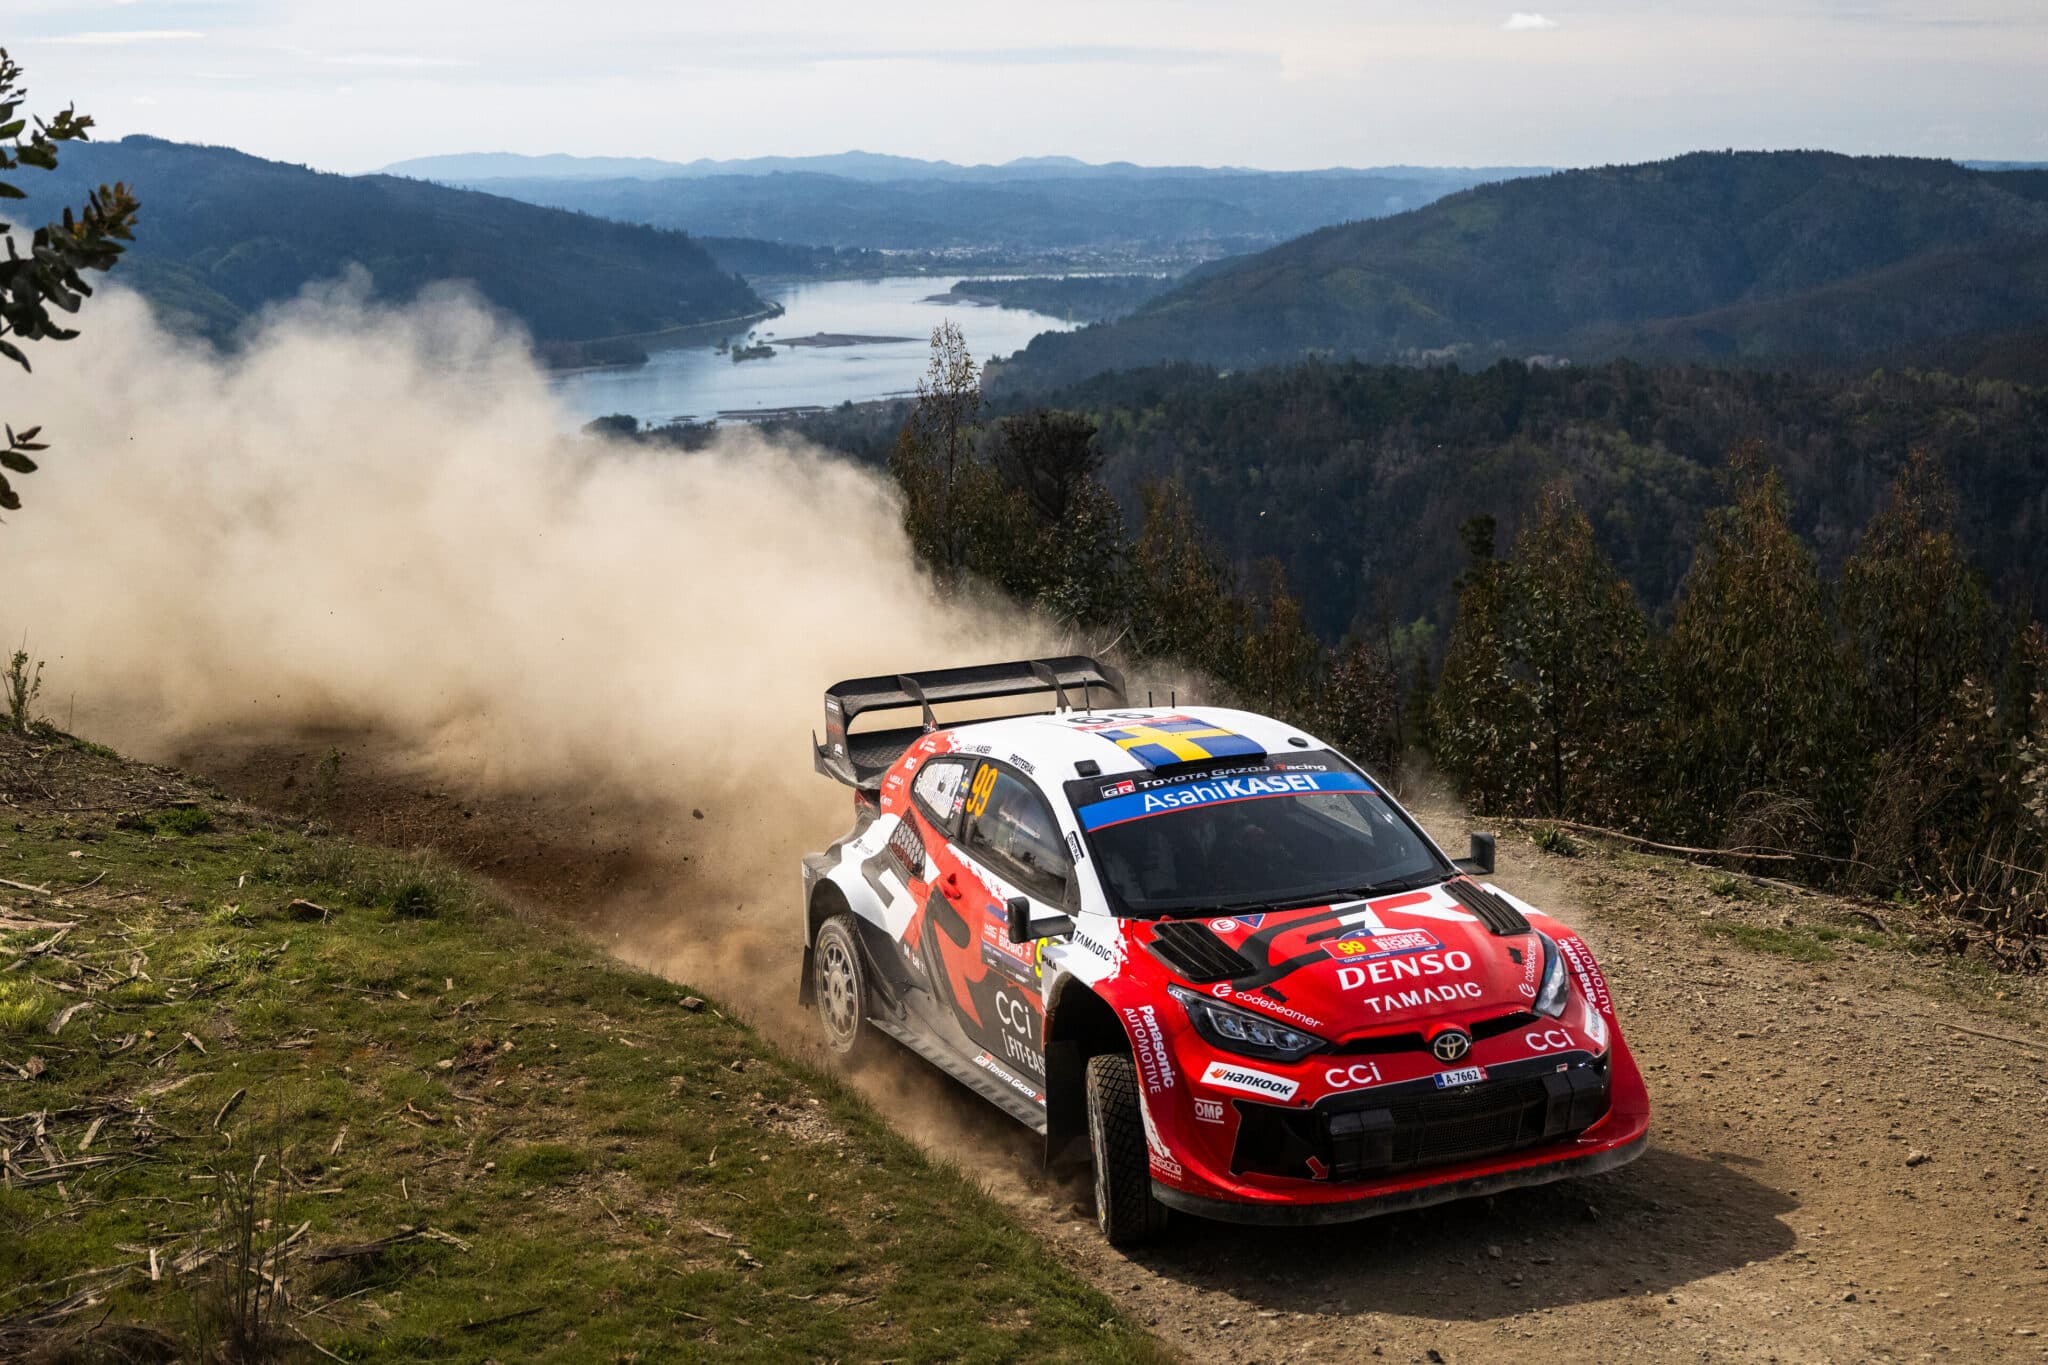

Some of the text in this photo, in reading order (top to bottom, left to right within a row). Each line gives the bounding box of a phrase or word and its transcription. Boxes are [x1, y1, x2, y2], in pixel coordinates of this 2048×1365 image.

[1009, 753, 1037, 776] PROTERIAL
[966, 763, 999, 818] 99
[1102, 781, 1136, 798] GR
[1138, 771, 1209, 789] TOYOTA
[1144, 774, 1320, 813] AsahiKASEI
[1074, 930, 1112, 961] TAMADIC
[1337, 940, 1367, 955] 99
[1525, 937, 1537, 983] codebeamer
[1042, 954, 1058, 972] PIAA
[1336, 950, 1472, 991] DENSO
[1568, 936, 1612, 1014] AUTOMOTIVE
[1235, 991, 1322, 1028] codebeamer
[1363, 981, 1482, 1014] TAMADIC
[996, 990, 1033, 1040] CCi
[1123, 1007, 1161, 1094] AUTOMOTIVE
[1138, 1005, 1176, 1088] Panasonic
[1525, 1028, 1576, 1051] CCi
[987, 1062, 1014, 1083] TOYOTA
[1325, 1061, 1382, 1089] CCi
[1445, 1069, 1479, 1084] A-7662
[1194, 1103, 1224, 1119] OMP
